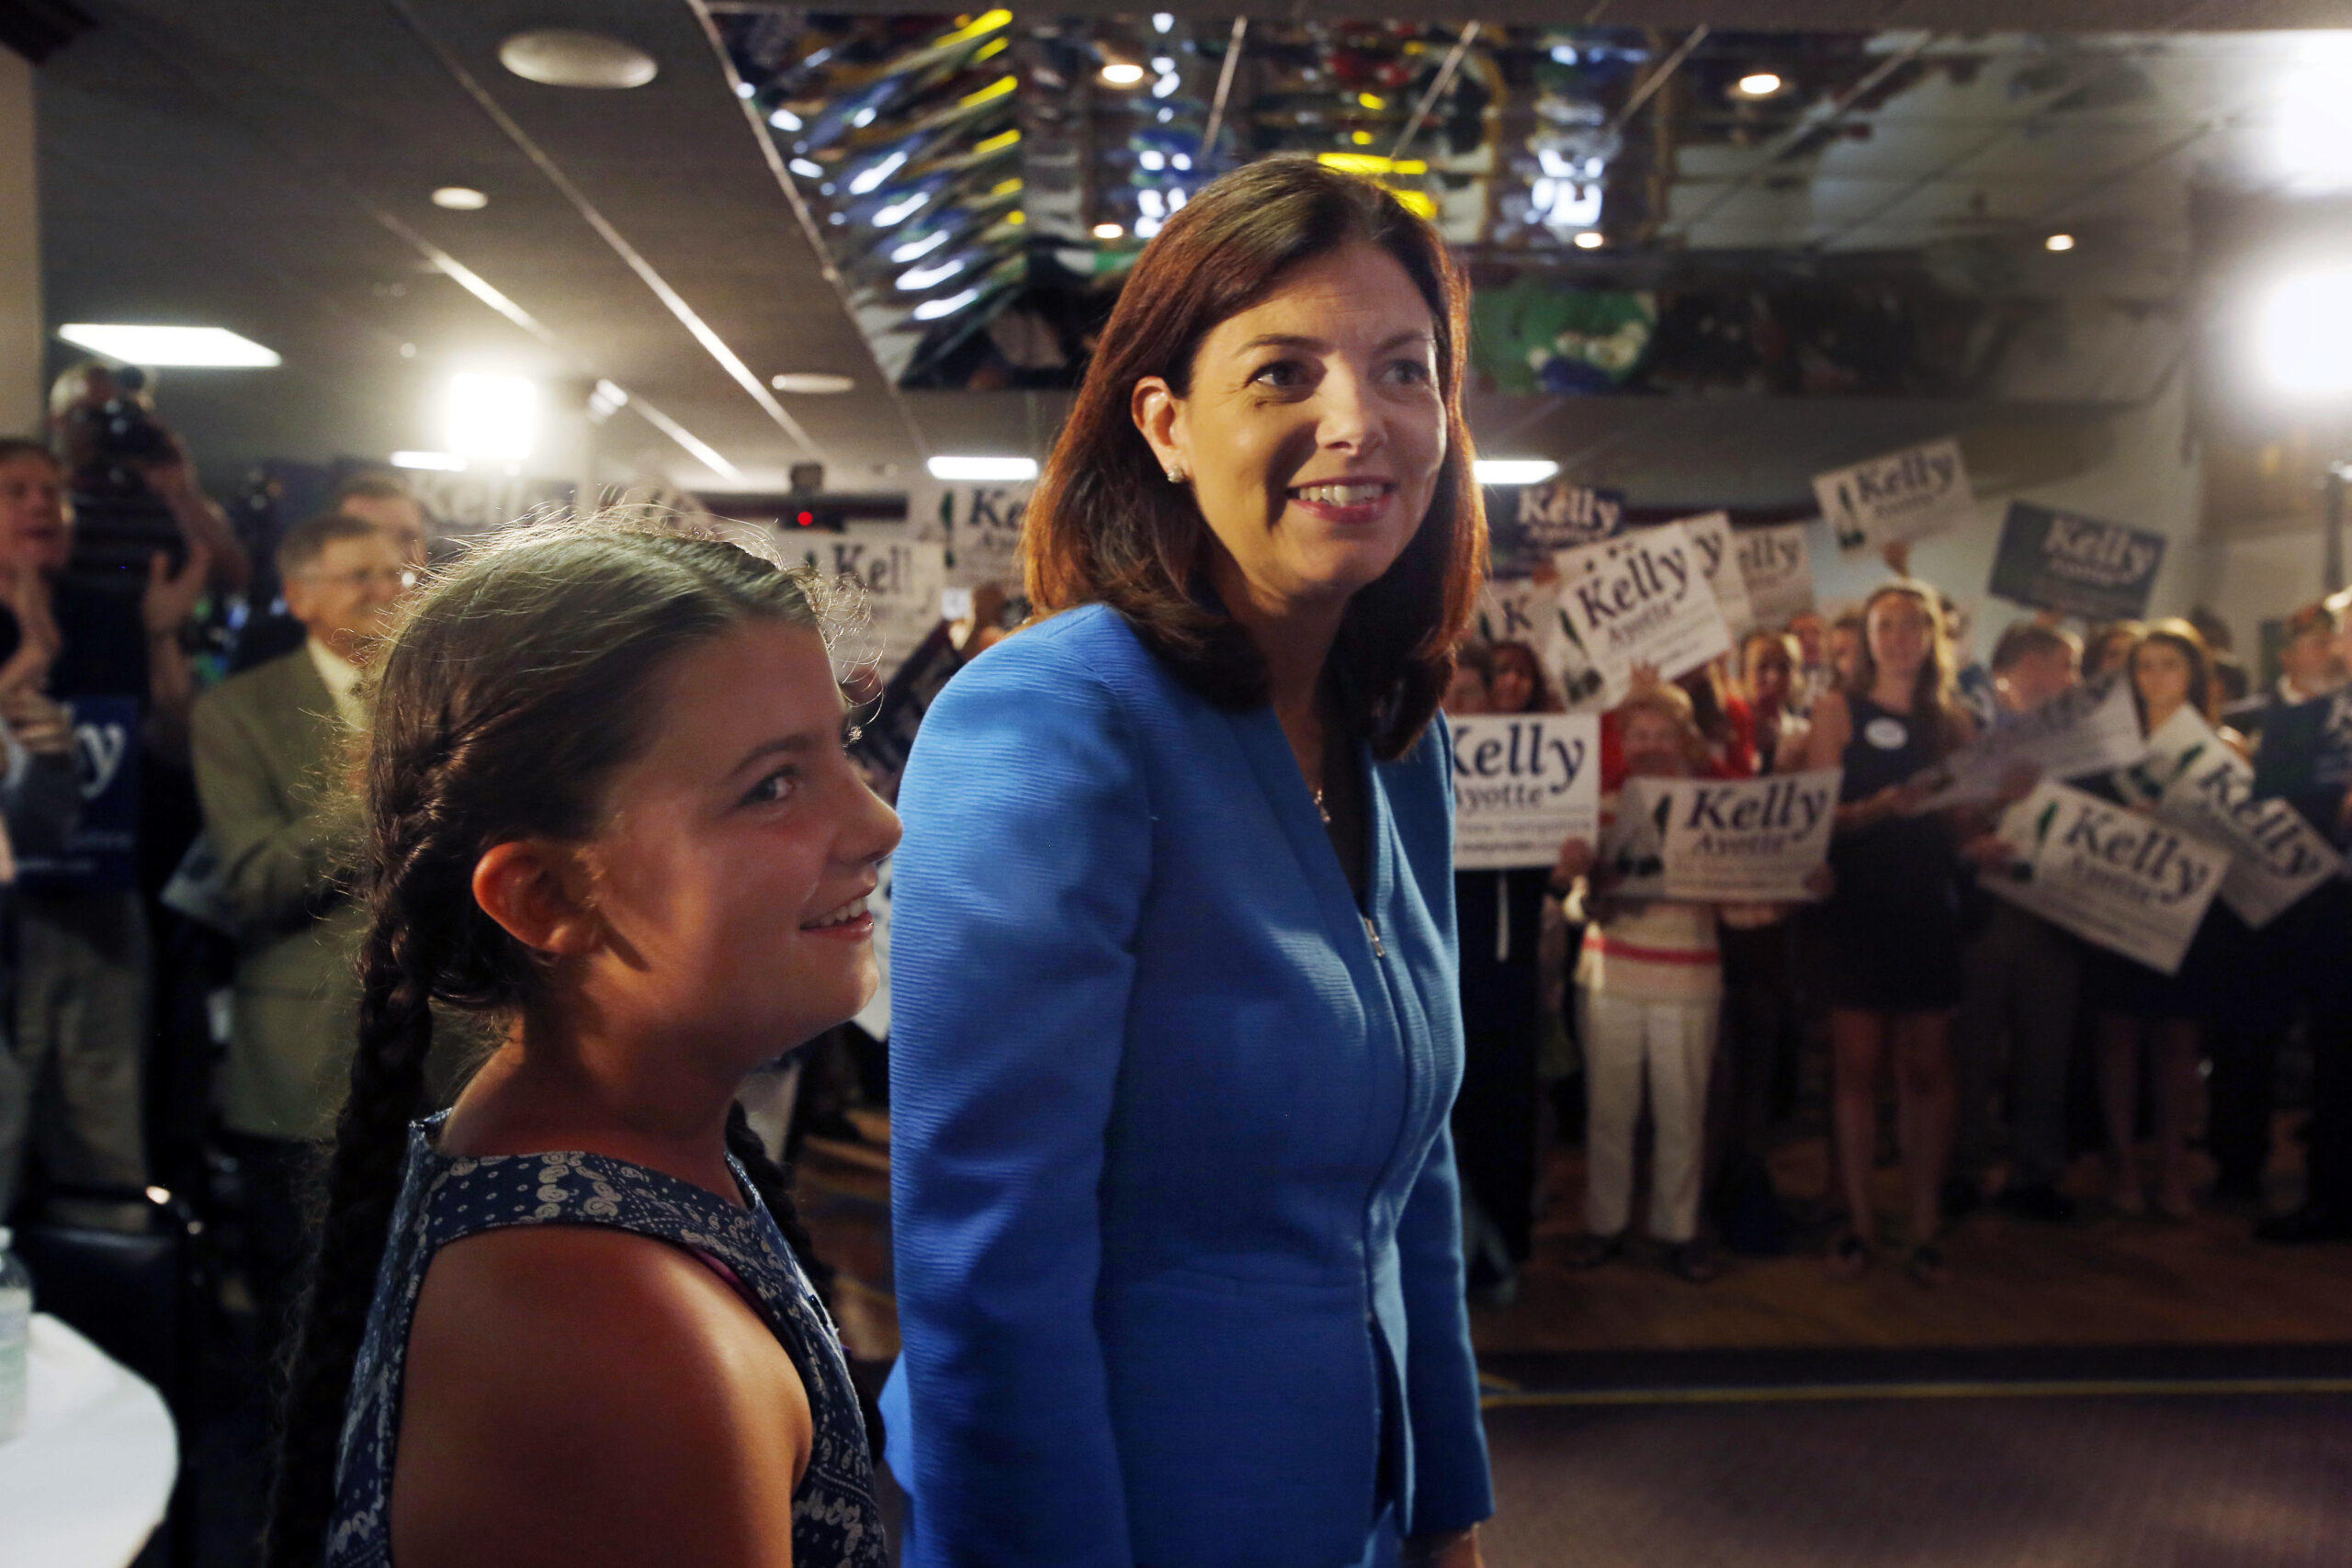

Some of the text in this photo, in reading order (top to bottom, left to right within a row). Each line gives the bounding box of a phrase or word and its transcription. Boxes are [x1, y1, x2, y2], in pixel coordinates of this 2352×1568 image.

[1857, 453, 1955, 502] Kelly
[1737, 536, 1802, 576] elly
[2044, 516, 2155, 585] Kelly
[1576, 548, 1690, 628] Kelly
[1685, 781, 1826, 842] Kelly
[2065, 806, 2209, 904] Kelly
